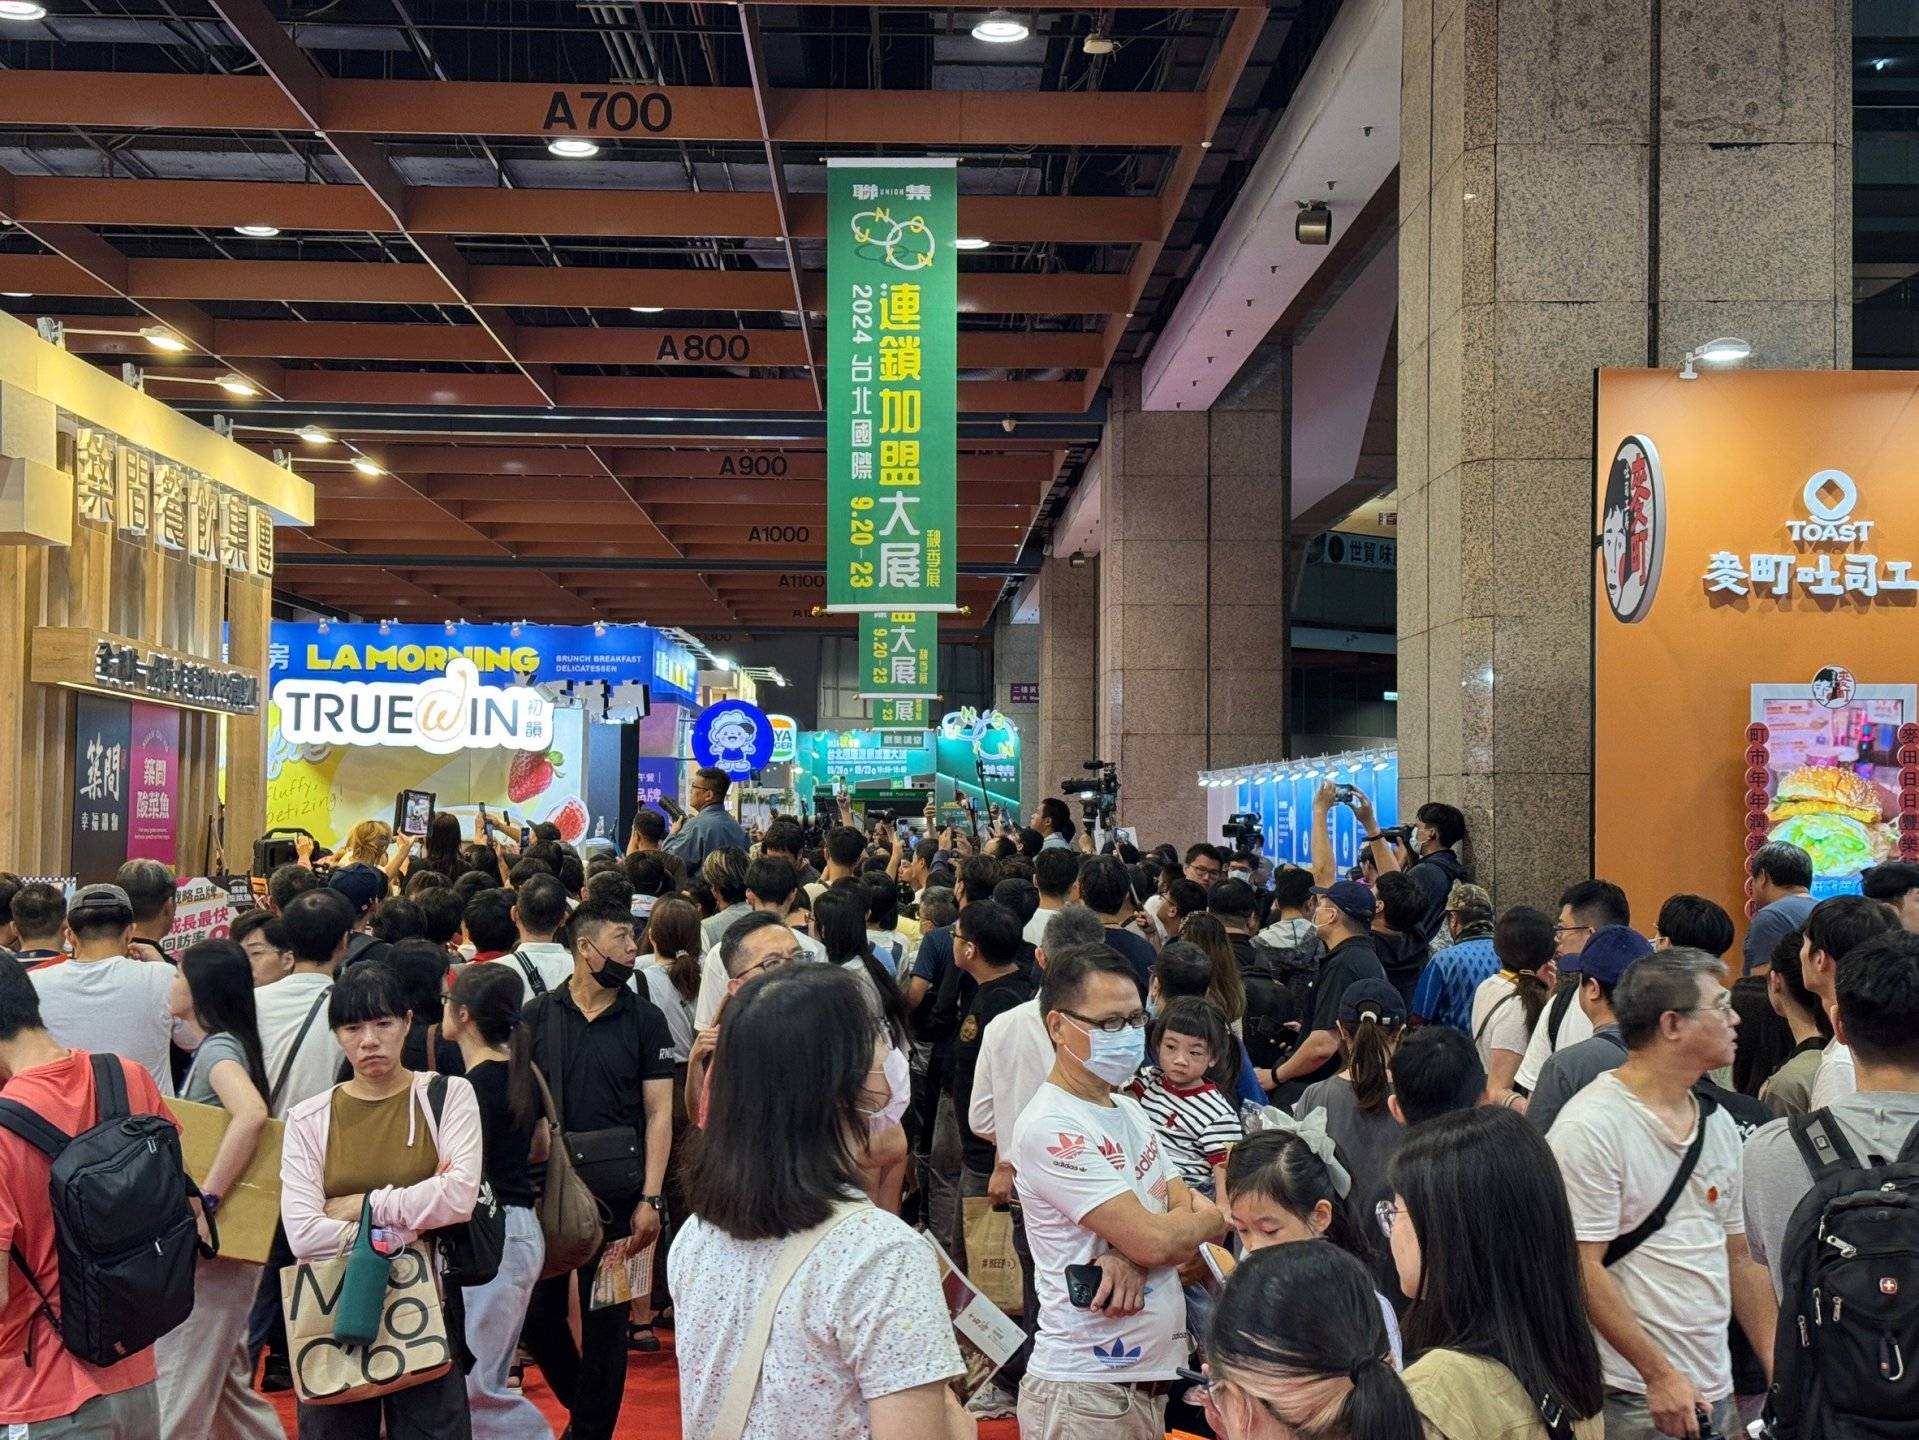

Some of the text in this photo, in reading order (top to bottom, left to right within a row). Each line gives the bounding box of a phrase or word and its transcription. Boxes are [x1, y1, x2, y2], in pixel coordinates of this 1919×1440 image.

[543, 91, 672, 132] A700
[852, 284, 873, 345] 2024
[656, 334, 750, 362] A800
[879, 283, 921, 588] 連鎖加盟大展
[719, 456, 787, 476] A900
[748, 526, 810, 544] A1000
[1785, 520, 1874, 542] TOAST
[1350, 541, 1397, 566] 世貿味
[778, 574, 825, 588] A1100
[307, 644, 362, 670] LA
[1012, 685, 1039, 694] 二樓展
